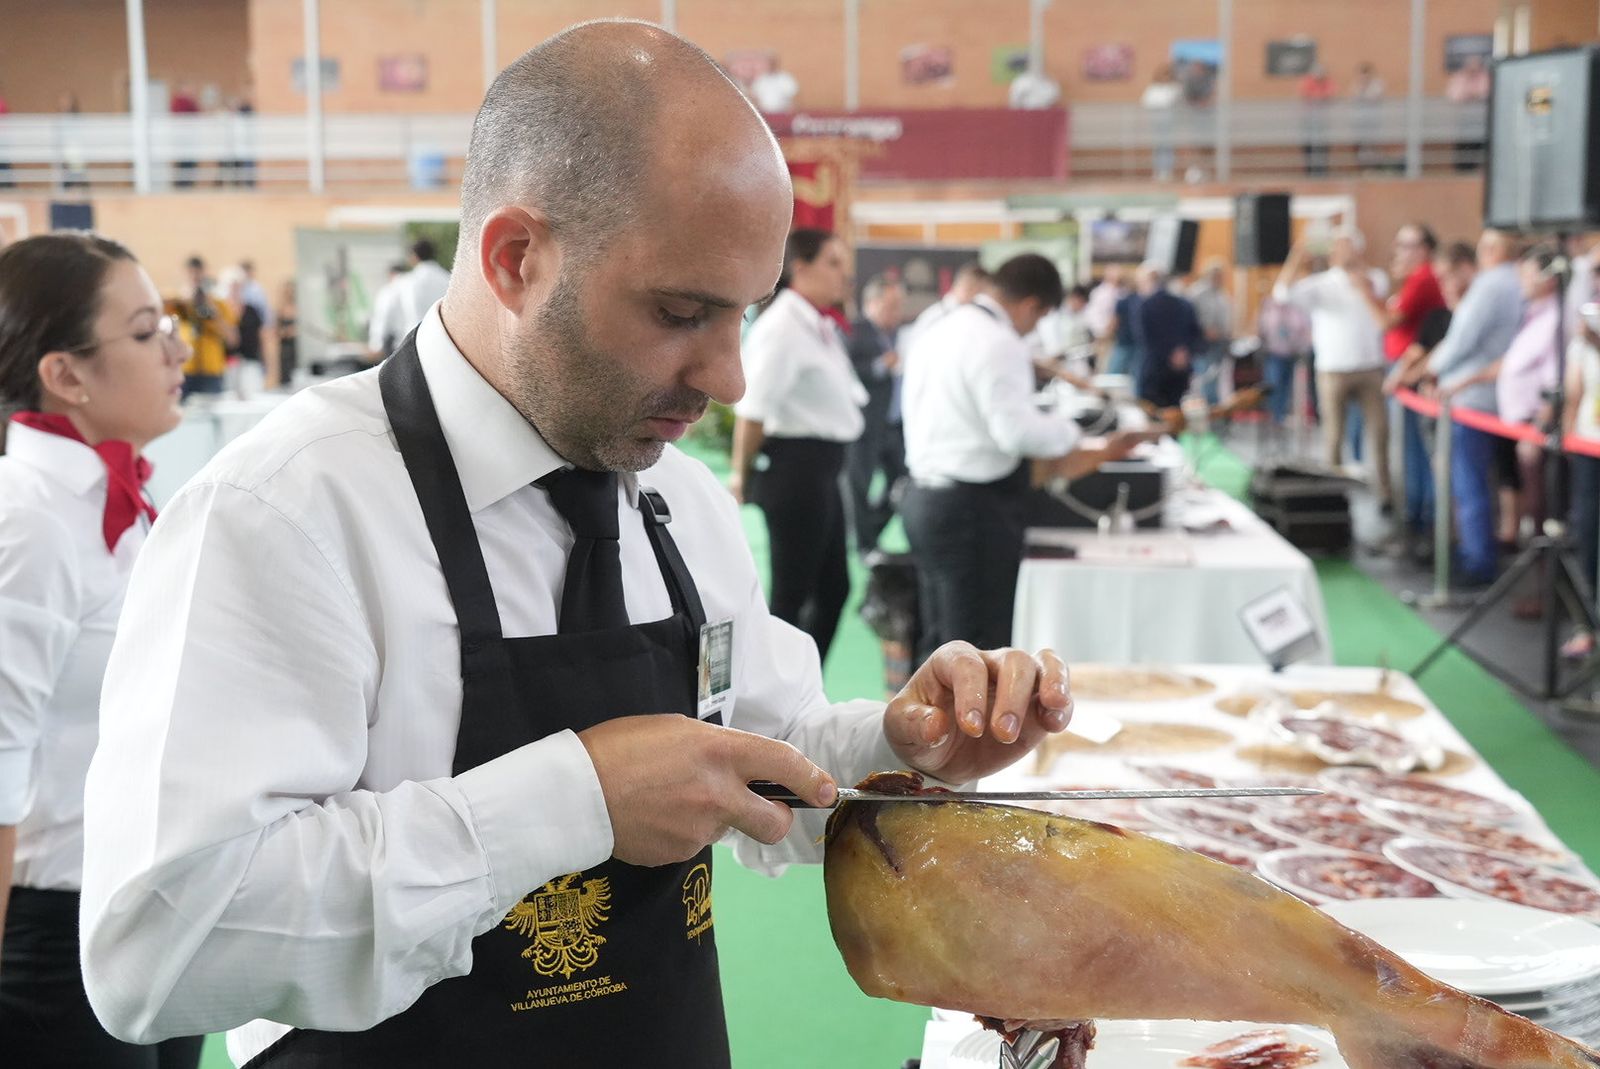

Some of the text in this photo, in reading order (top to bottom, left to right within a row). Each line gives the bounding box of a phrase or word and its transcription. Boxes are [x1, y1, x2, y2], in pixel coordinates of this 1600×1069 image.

[510, 982, 628, 1012] VILLANUEVA DE CÓRDOBA
[526, 975, 612, 999] AYUNTAMIENTO DE
